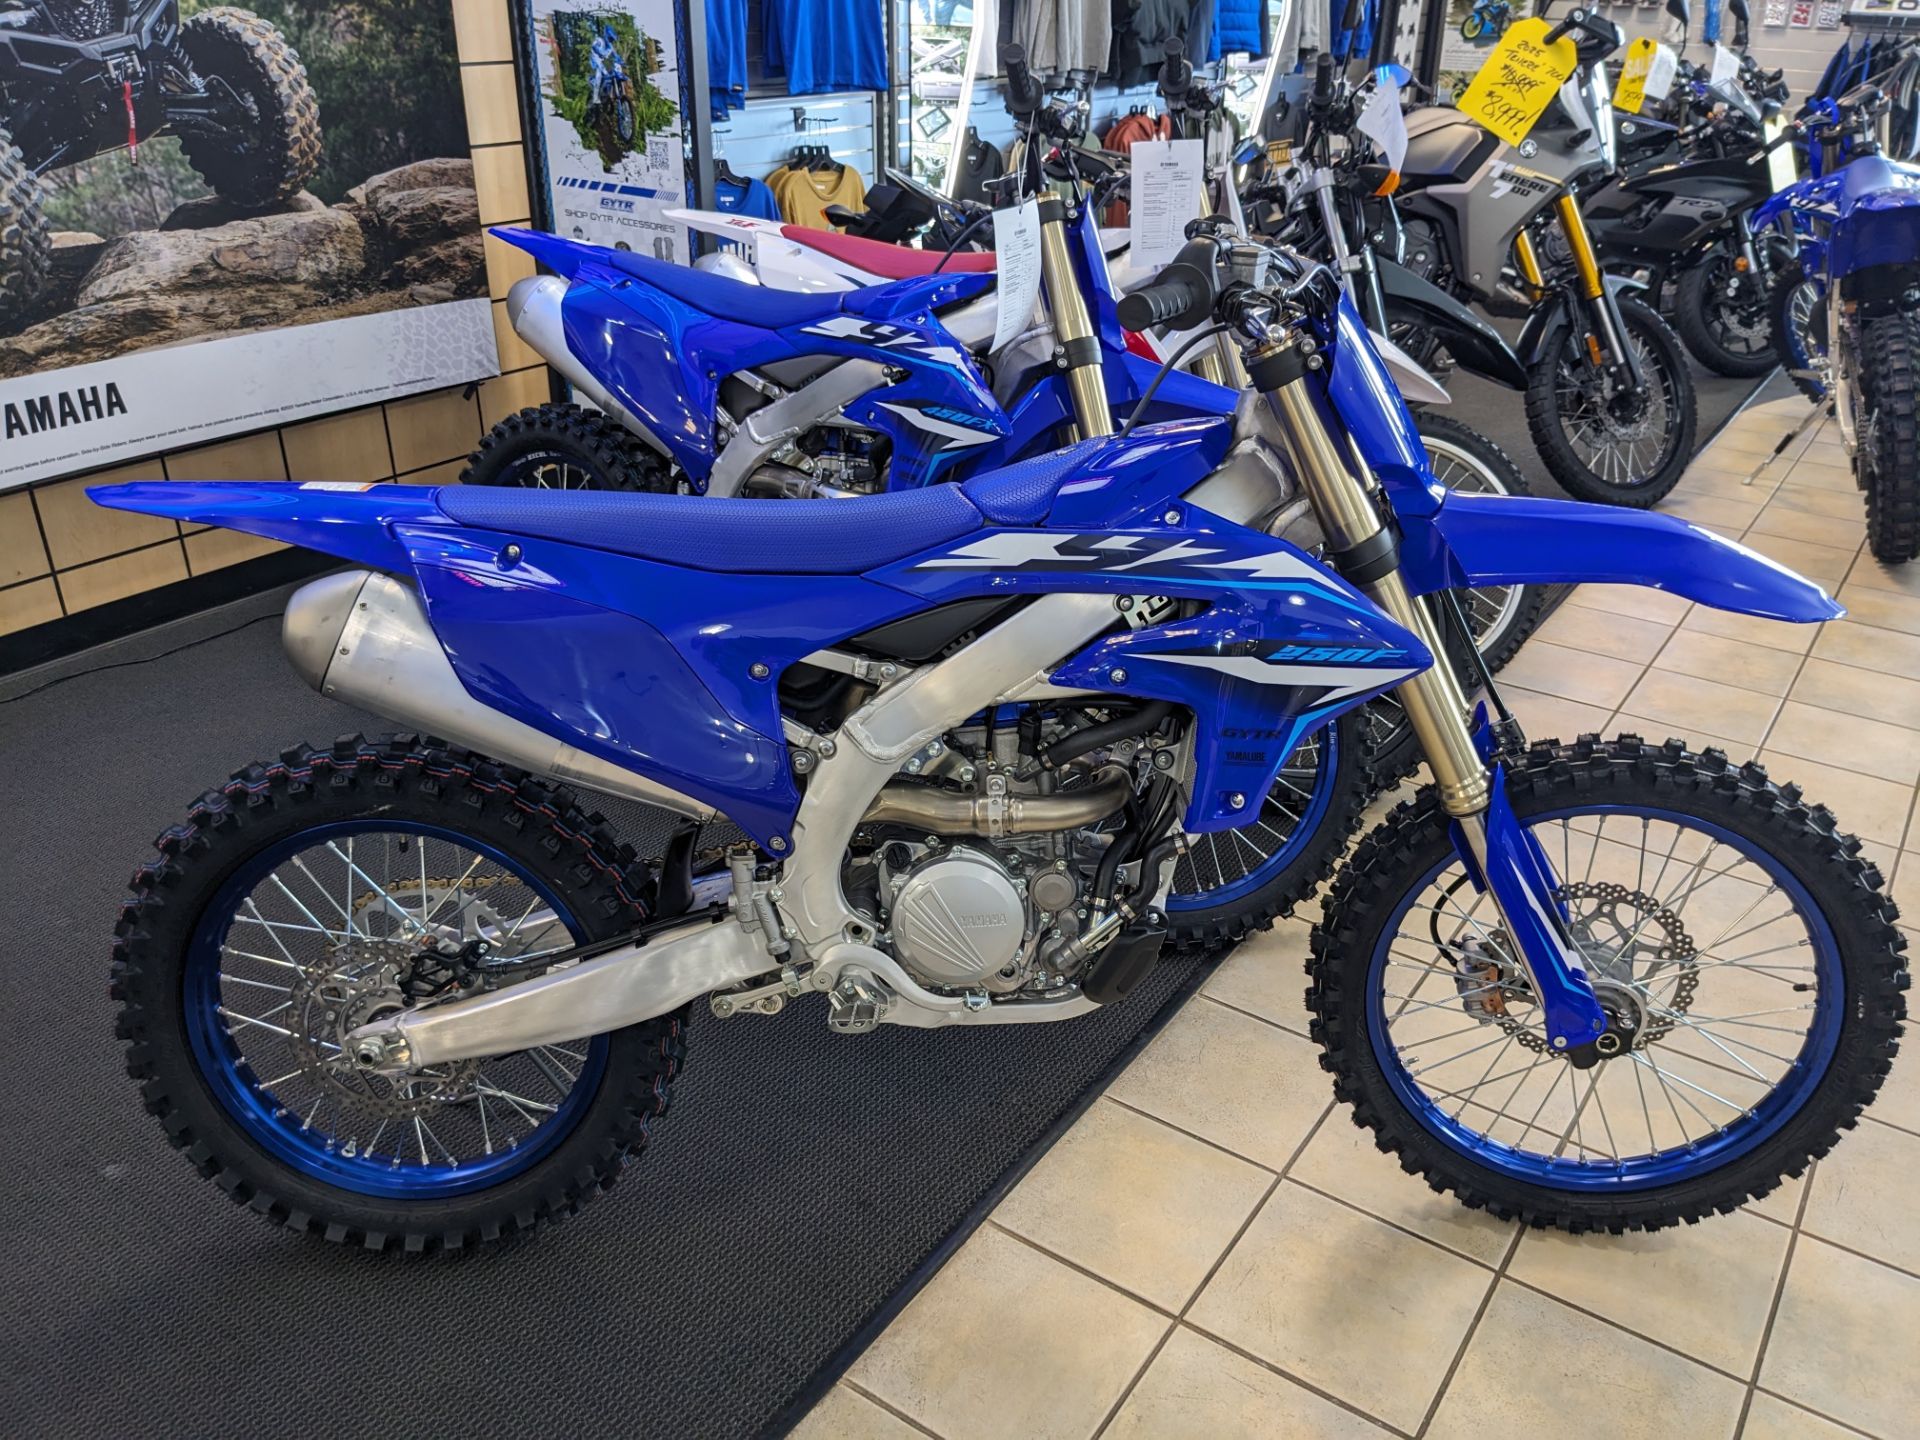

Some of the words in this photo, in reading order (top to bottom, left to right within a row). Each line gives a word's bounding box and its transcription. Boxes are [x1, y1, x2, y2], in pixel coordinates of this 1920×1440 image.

[600, 197, 635, 209] GYTR
[564, 209, 588, 217] SHOP
[616, 217, 676, 233] ACCESSORIES
[4, 382, 128, 440] AMAHA
[1266, 646, 1408, 663] 250F
[1222, 727, 1283, 740] GYTR
[1225, 751, 1267, 762] YAMALUBE
[960, 913, 1008, 929] YAMAHA
